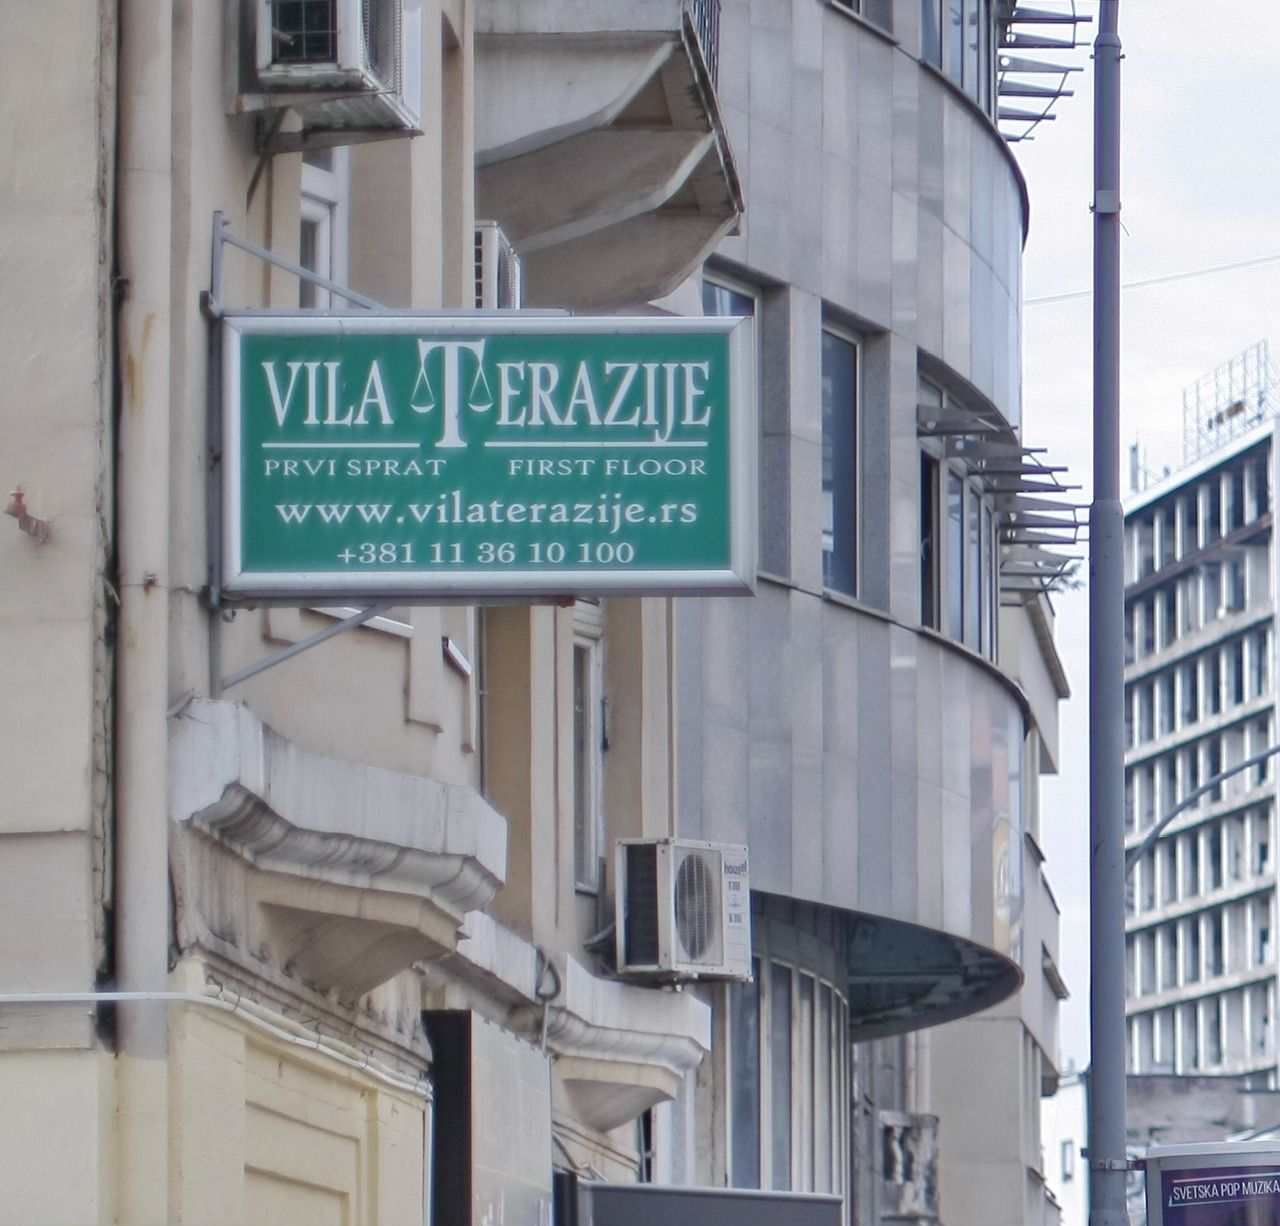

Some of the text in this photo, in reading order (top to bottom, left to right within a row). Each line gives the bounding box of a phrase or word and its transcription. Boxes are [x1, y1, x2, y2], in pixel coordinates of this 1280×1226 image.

[261, 338, 712, 448] VILA TERAZIJE
[264, 458, 708, 476] PRVI SPRAT FIRST FLOOR
[275, 489, 698, 534] www.vilaterazije.rs
[337, 542, 635, 564] +381 11 36 10 100
[1172, 1182, 1218, 1201] SVETSKA
[1221, 1182, 1240, 1197] POP
[1242, 1179, 1280, 1196] MUZIKA
